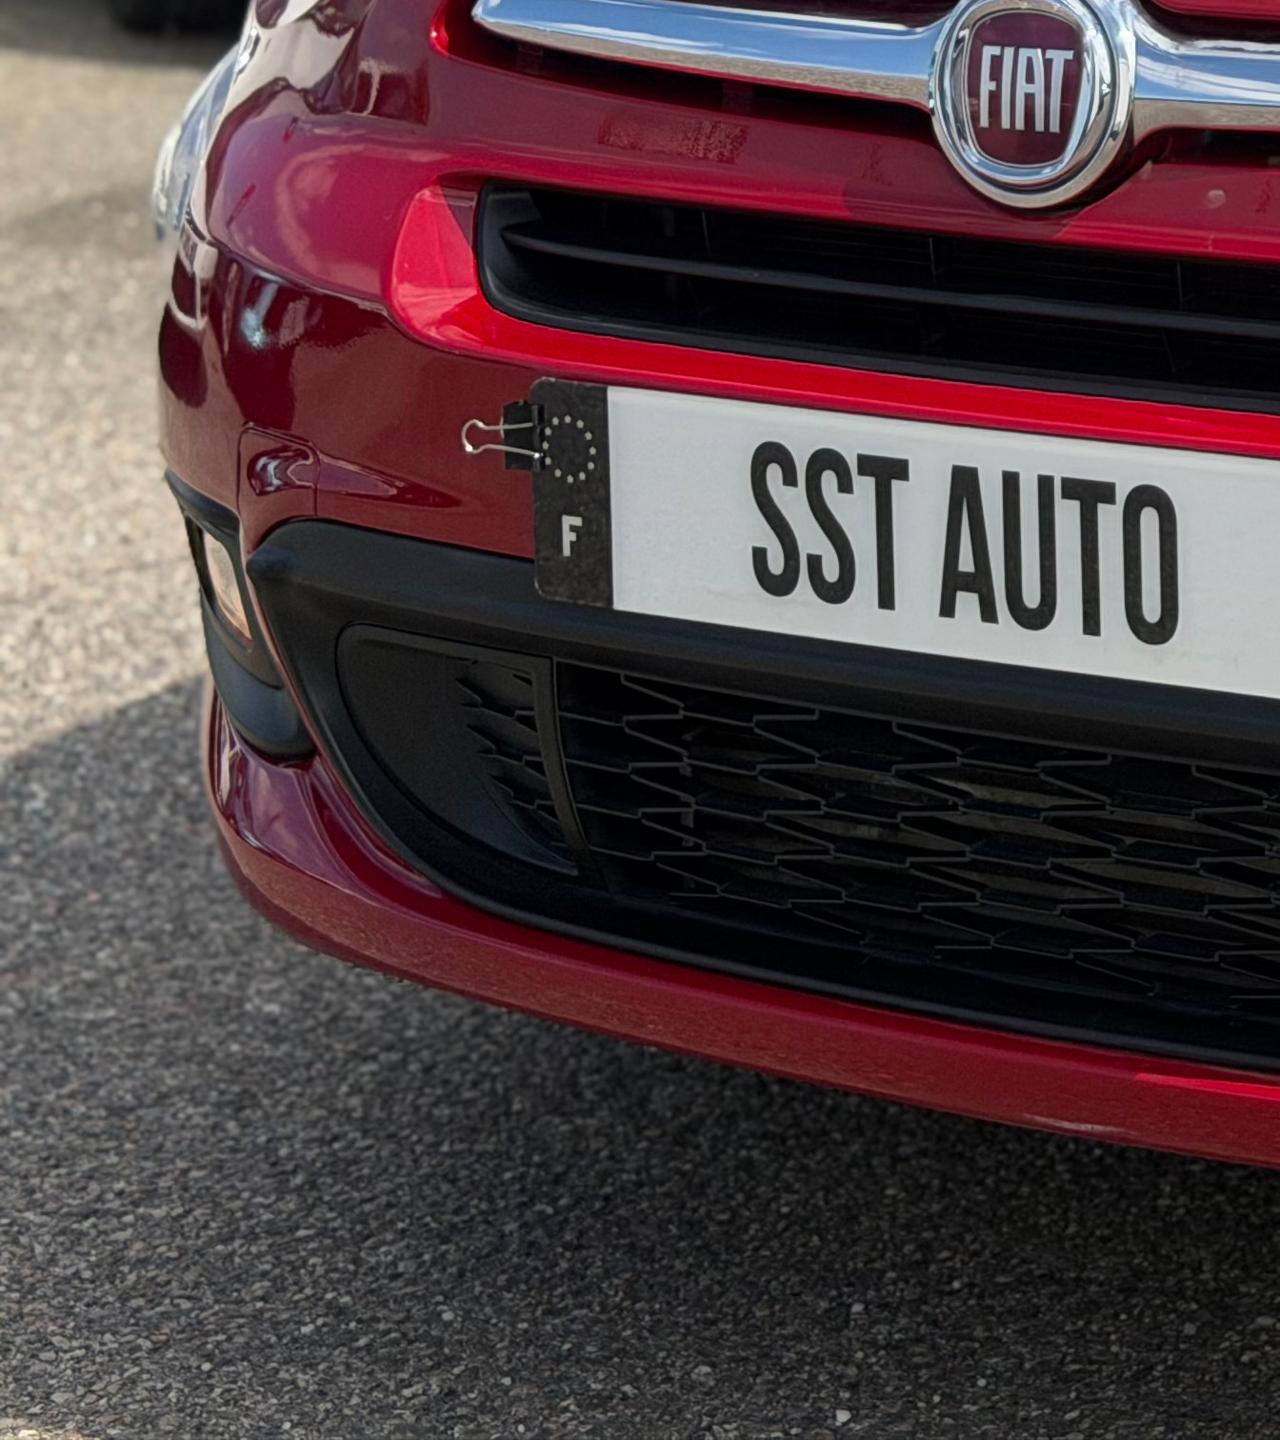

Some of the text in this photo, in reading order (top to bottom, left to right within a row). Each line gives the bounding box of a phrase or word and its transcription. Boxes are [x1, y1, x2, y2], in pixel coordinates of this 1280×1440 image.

[979, 45, 1075, 134] FIAT
[561, 514, 583, 558] F
[750, 440, 1180, 646] SST AUTO
